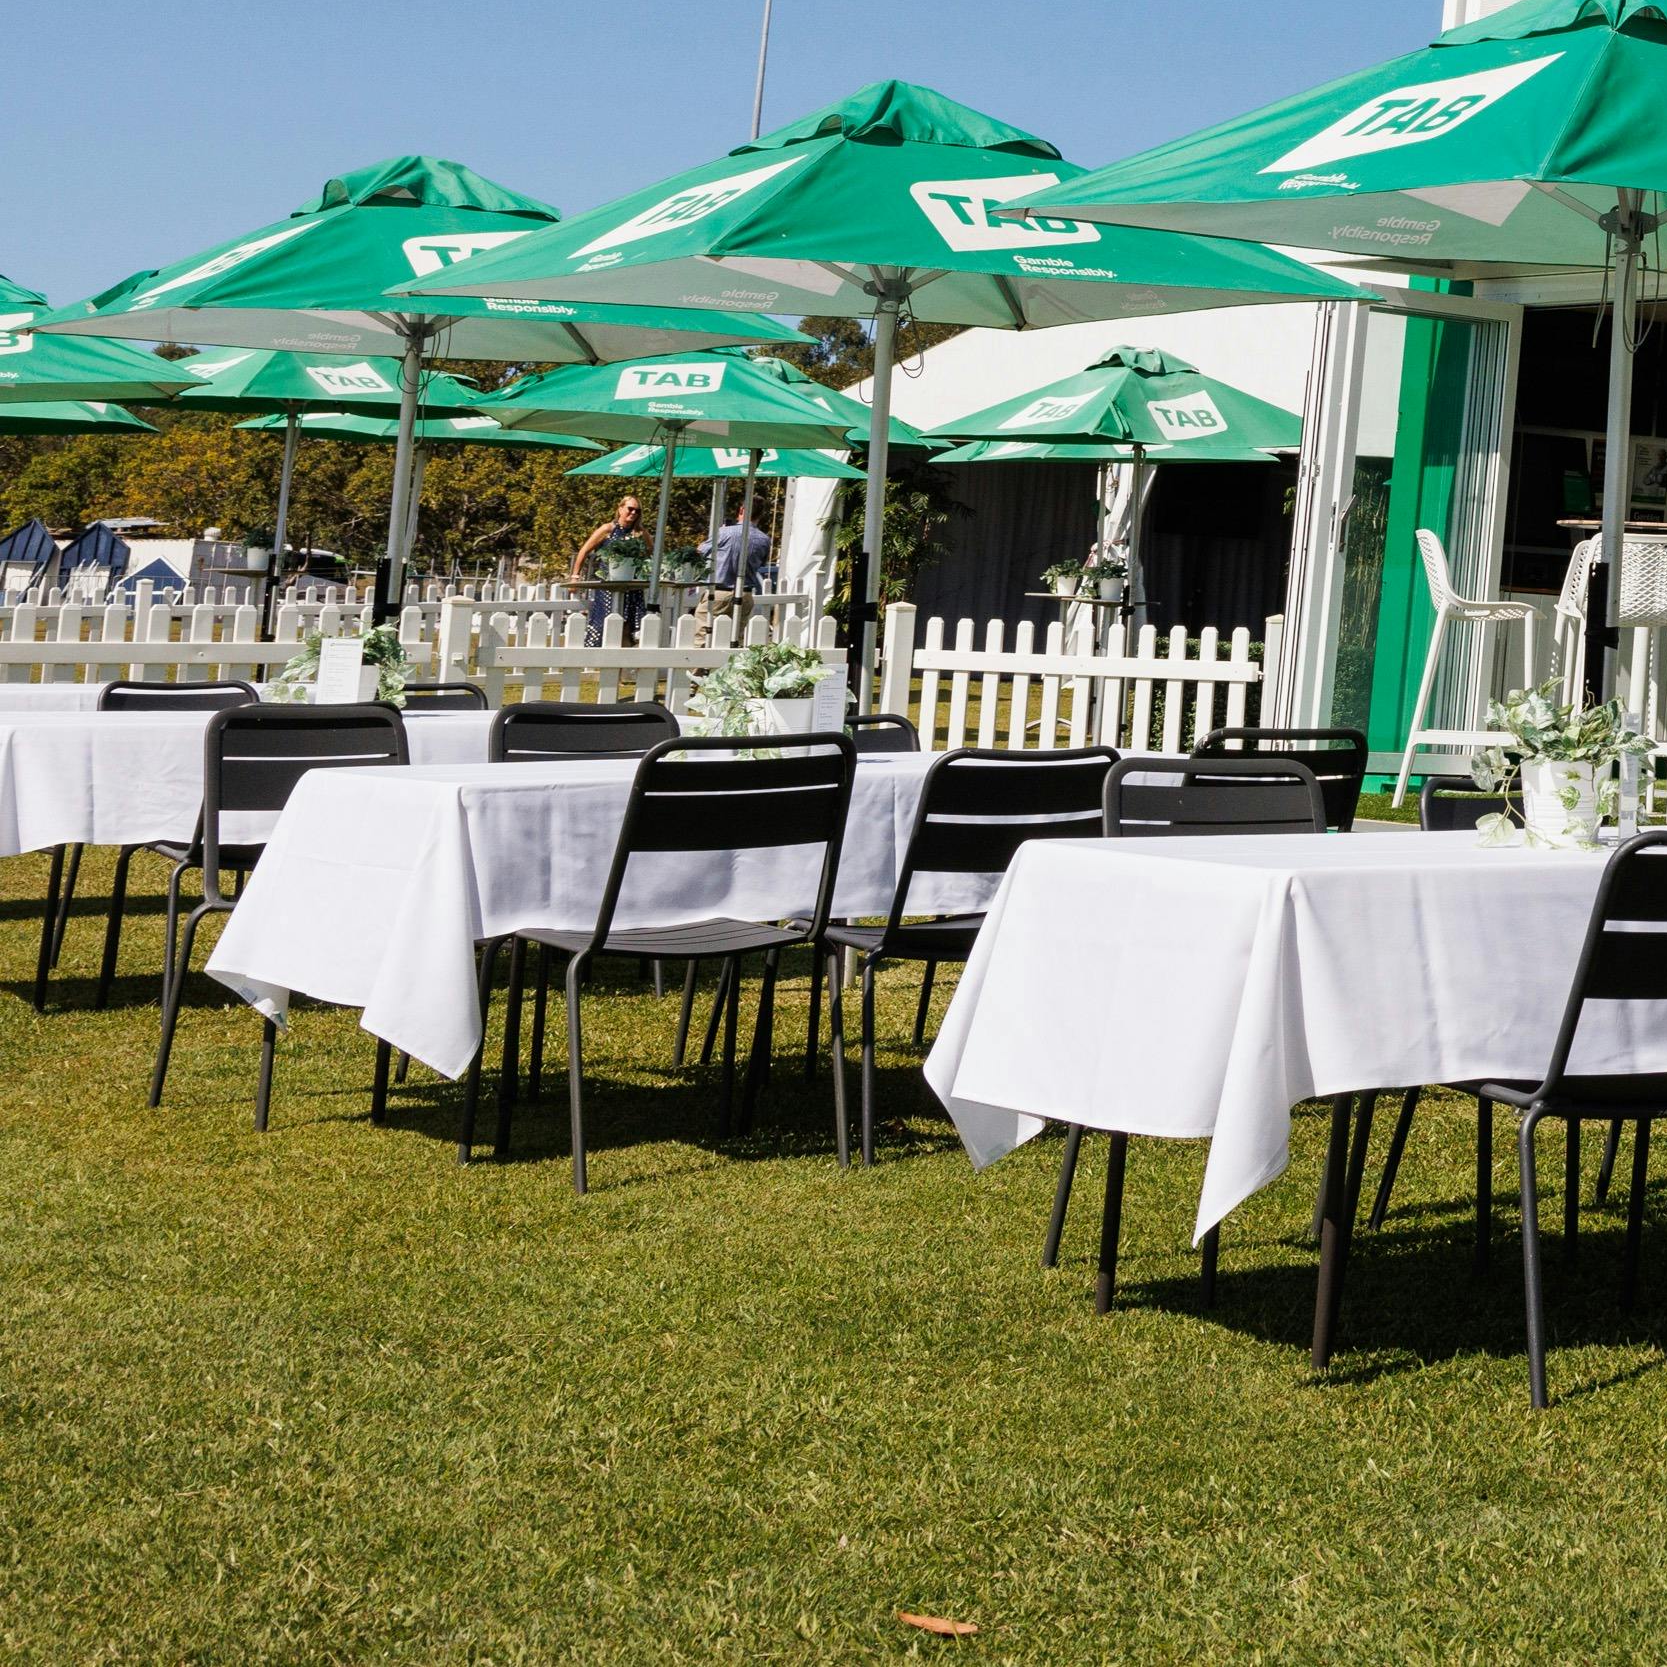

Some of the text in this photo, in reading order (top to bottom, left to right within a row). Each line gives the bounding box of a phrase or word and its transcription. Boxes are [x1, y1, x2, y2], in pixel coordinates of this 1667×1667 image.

[1340, 94, 1488, 138] TAB
[1012, 254, 1075, 268] Gamble
[1019, 262, 1119, 278] Responsibly.
[487, 301, 578, 316] Responsibly.
[315, 369, 383, 390] TAB
[632, 370, 711, 388] TAB
[1027, 401, 1079, 419] TAB
[1155, 406, 1218, 428] TAB
